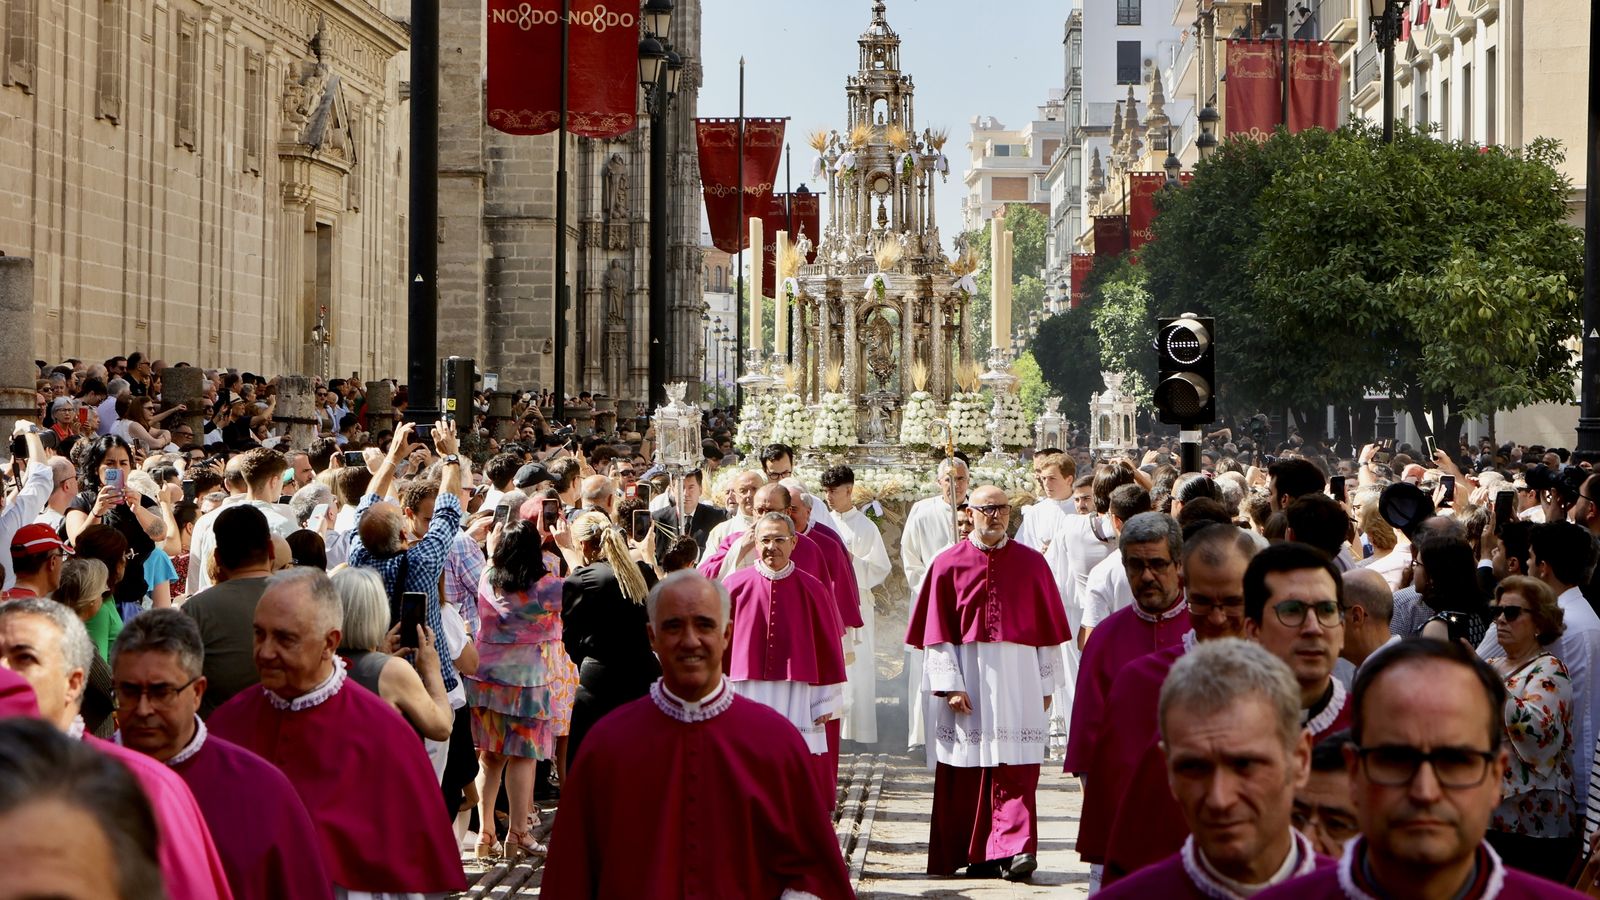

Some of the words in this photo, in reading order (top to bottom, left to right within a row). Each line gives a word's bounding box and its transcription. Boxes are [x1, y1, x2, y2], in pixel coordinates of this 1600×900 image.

[492, 2, 558, 31] NO8DO
[568, 4, 634, 33] NO8DO
[1133, 226, 1154, 241] NO8
